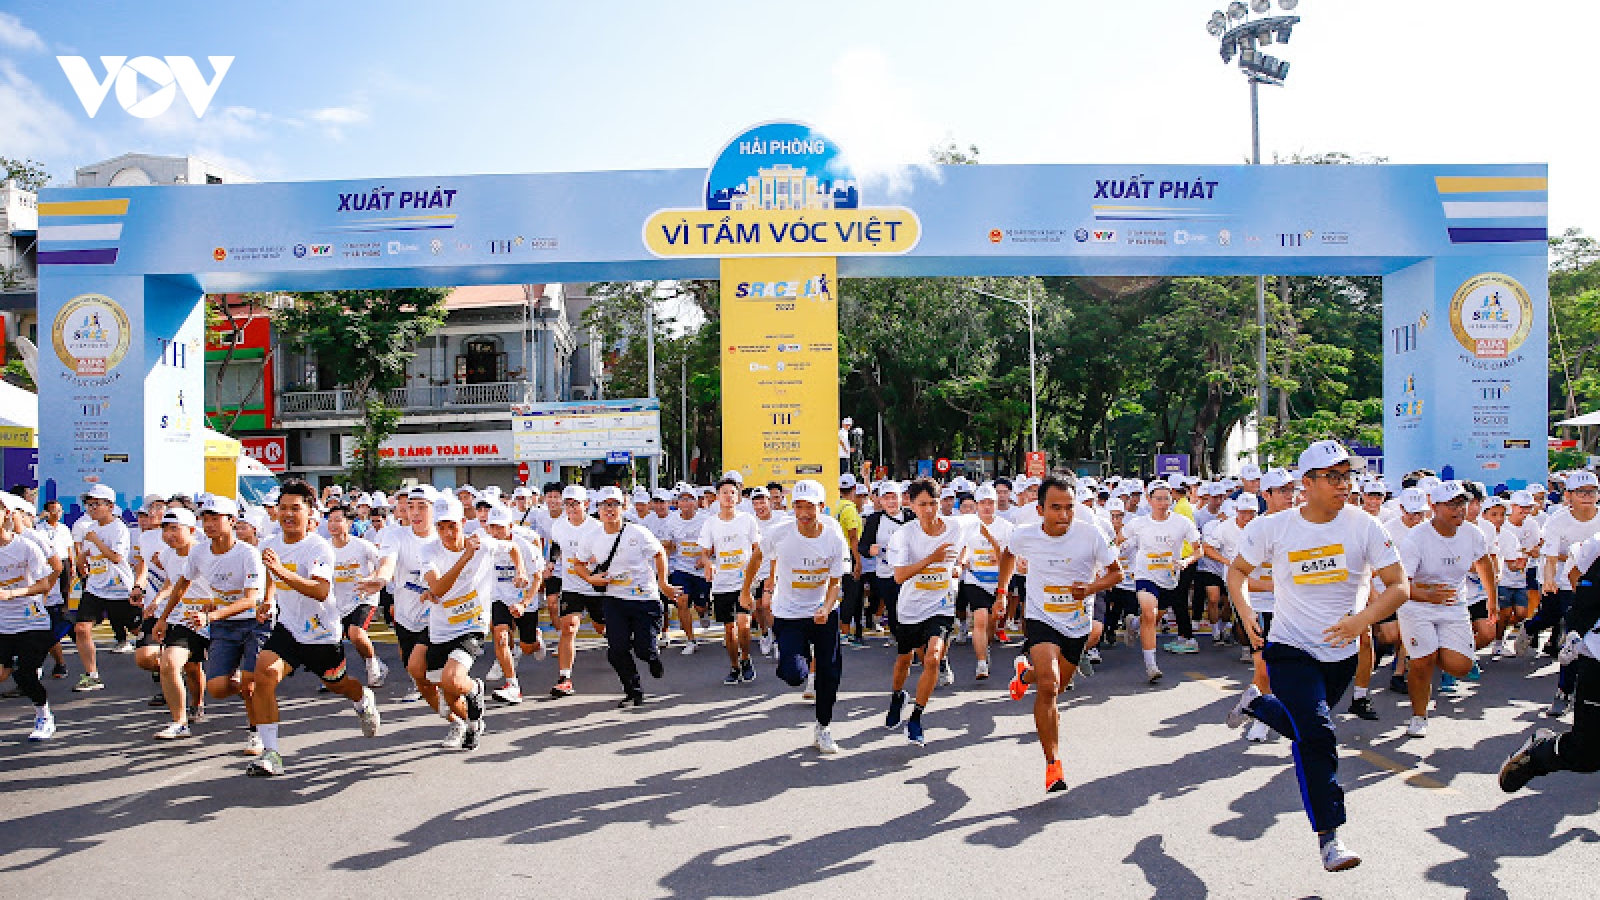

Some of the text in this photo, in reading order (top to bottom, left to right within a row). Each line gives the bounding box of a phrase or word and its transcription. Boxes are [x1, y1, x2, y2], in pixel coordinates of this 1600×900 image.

[739, 136, 825, 155] HẢI PHÒNG
[337, 185, 457, 212] XUẤT PHÁT
[1093, 173, 1219, 199] XUẤT PHÁT
[661, 218, 689, 245] VÌ
[768, 215, 828, 243] VÓC
[834, 215, 903, 247] VIỆT
[157, 337, 187, 369] TH
[1301, 557, 1337, 572] 6454
